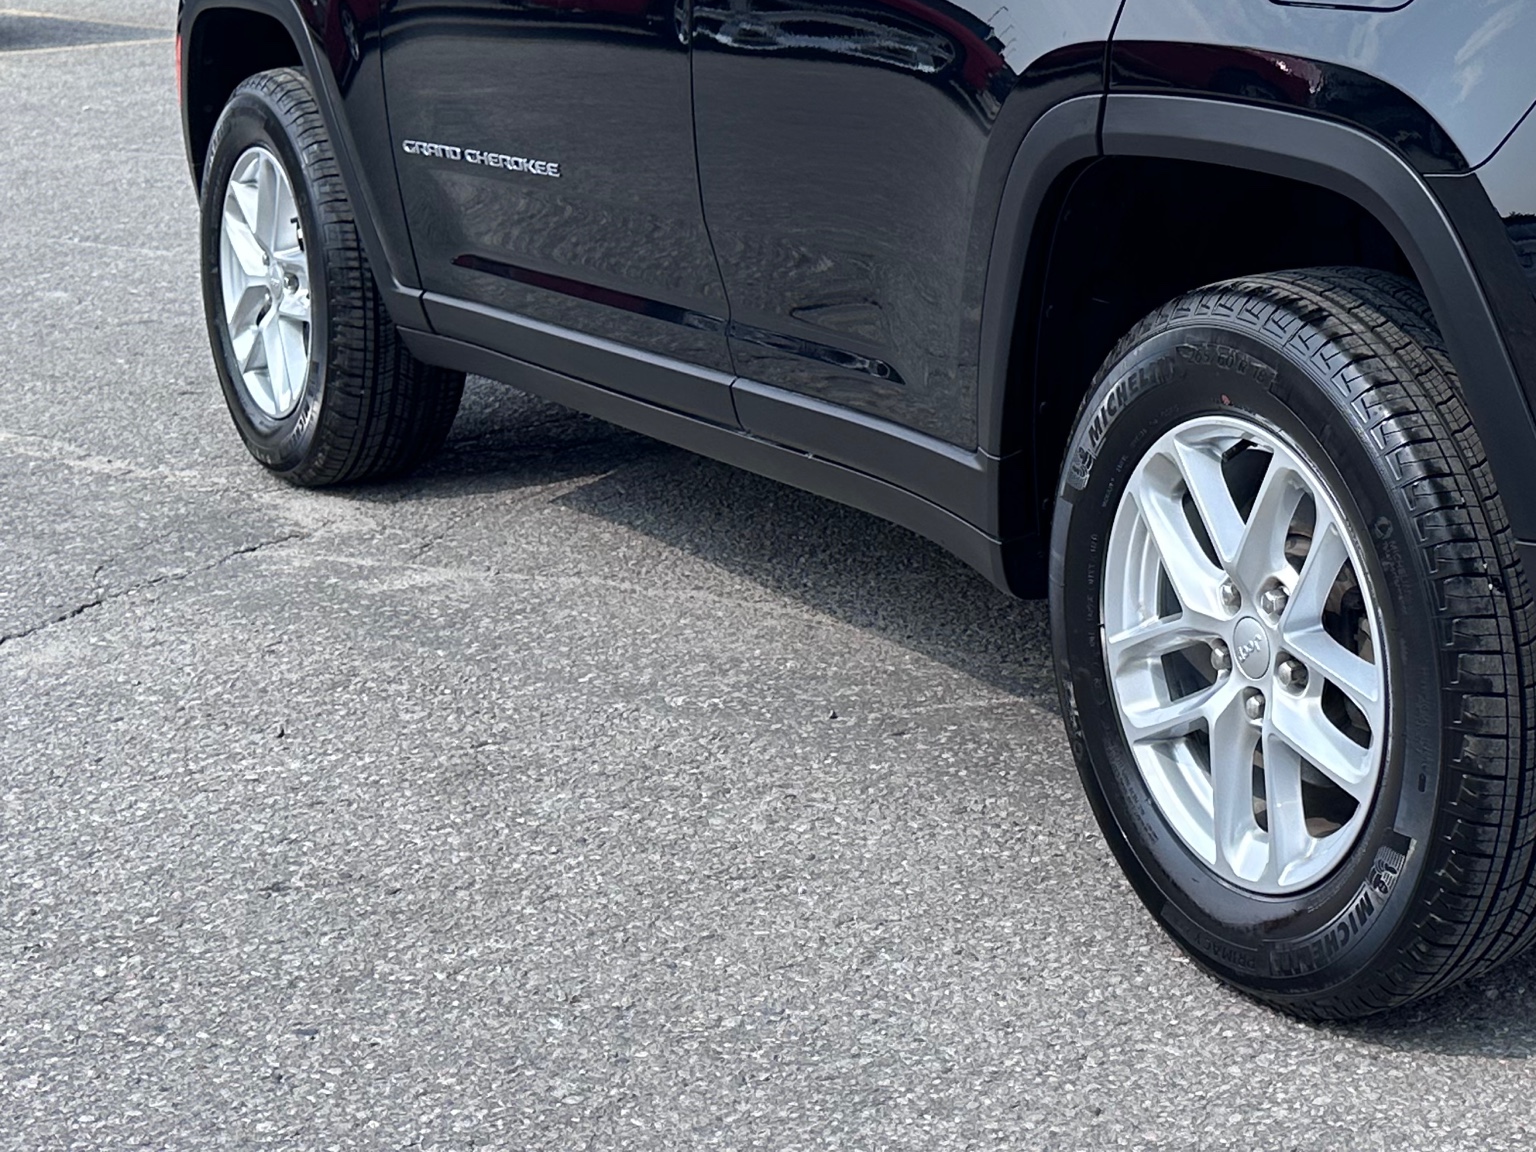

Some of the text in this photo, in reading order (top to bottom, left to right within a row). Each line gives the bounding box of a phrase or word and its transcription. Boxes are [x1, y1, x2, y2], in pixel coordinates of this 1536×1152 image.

[402, 139, 561, 178] GRAND CHEROKEE
[1088, 356, 1176, 449] MICHELIN
